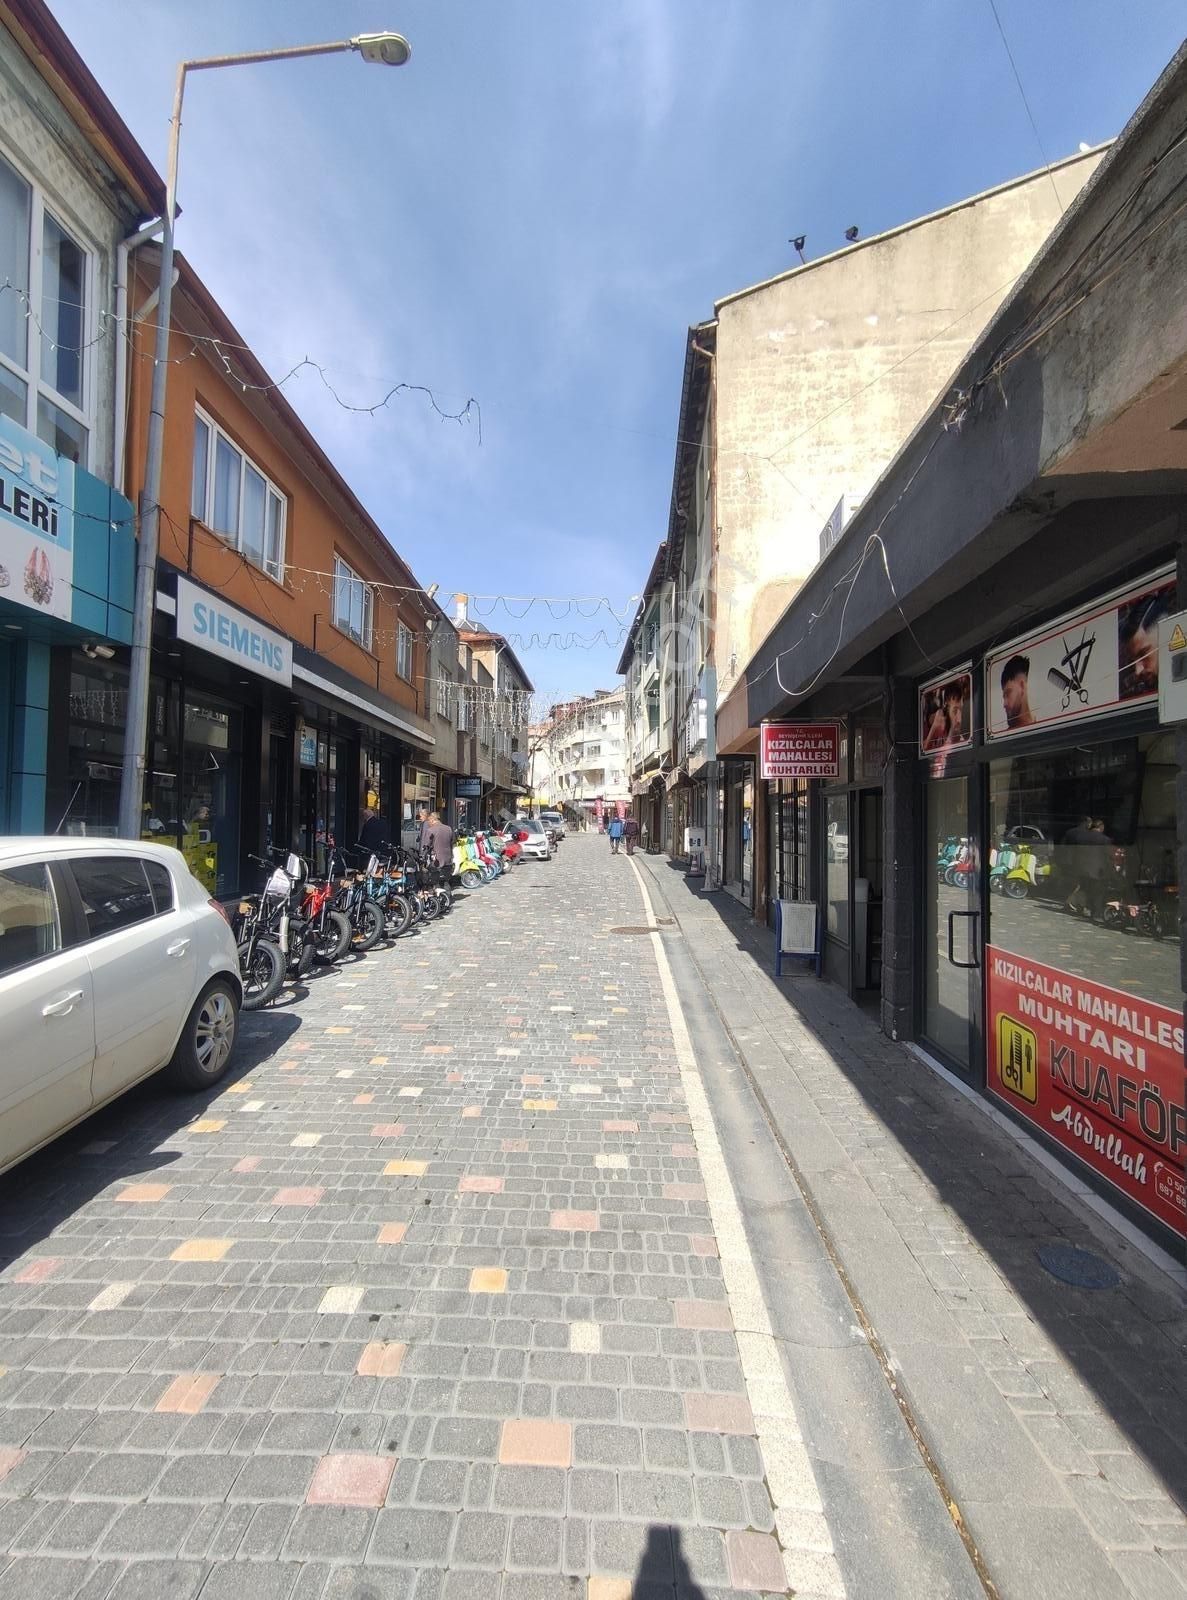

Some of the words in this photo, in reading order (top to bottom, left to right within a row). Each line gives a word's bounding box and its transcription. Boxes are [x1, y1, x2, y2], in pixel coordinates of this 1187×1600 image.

[193, 602, 284, 672] SIEMENS
[768, 740, 833, 749] KIZILCALAR
[769, 751, 832, 761] MAHALLESİ
[767, 765, 835, 774] MUHTARLIĞI
[994, 958, 1073, 1007] KIZILCALAR
[1018, 993, 1147, 1072] MUHTARI
[1050, 1104, 1147, 1185] Abdullah
